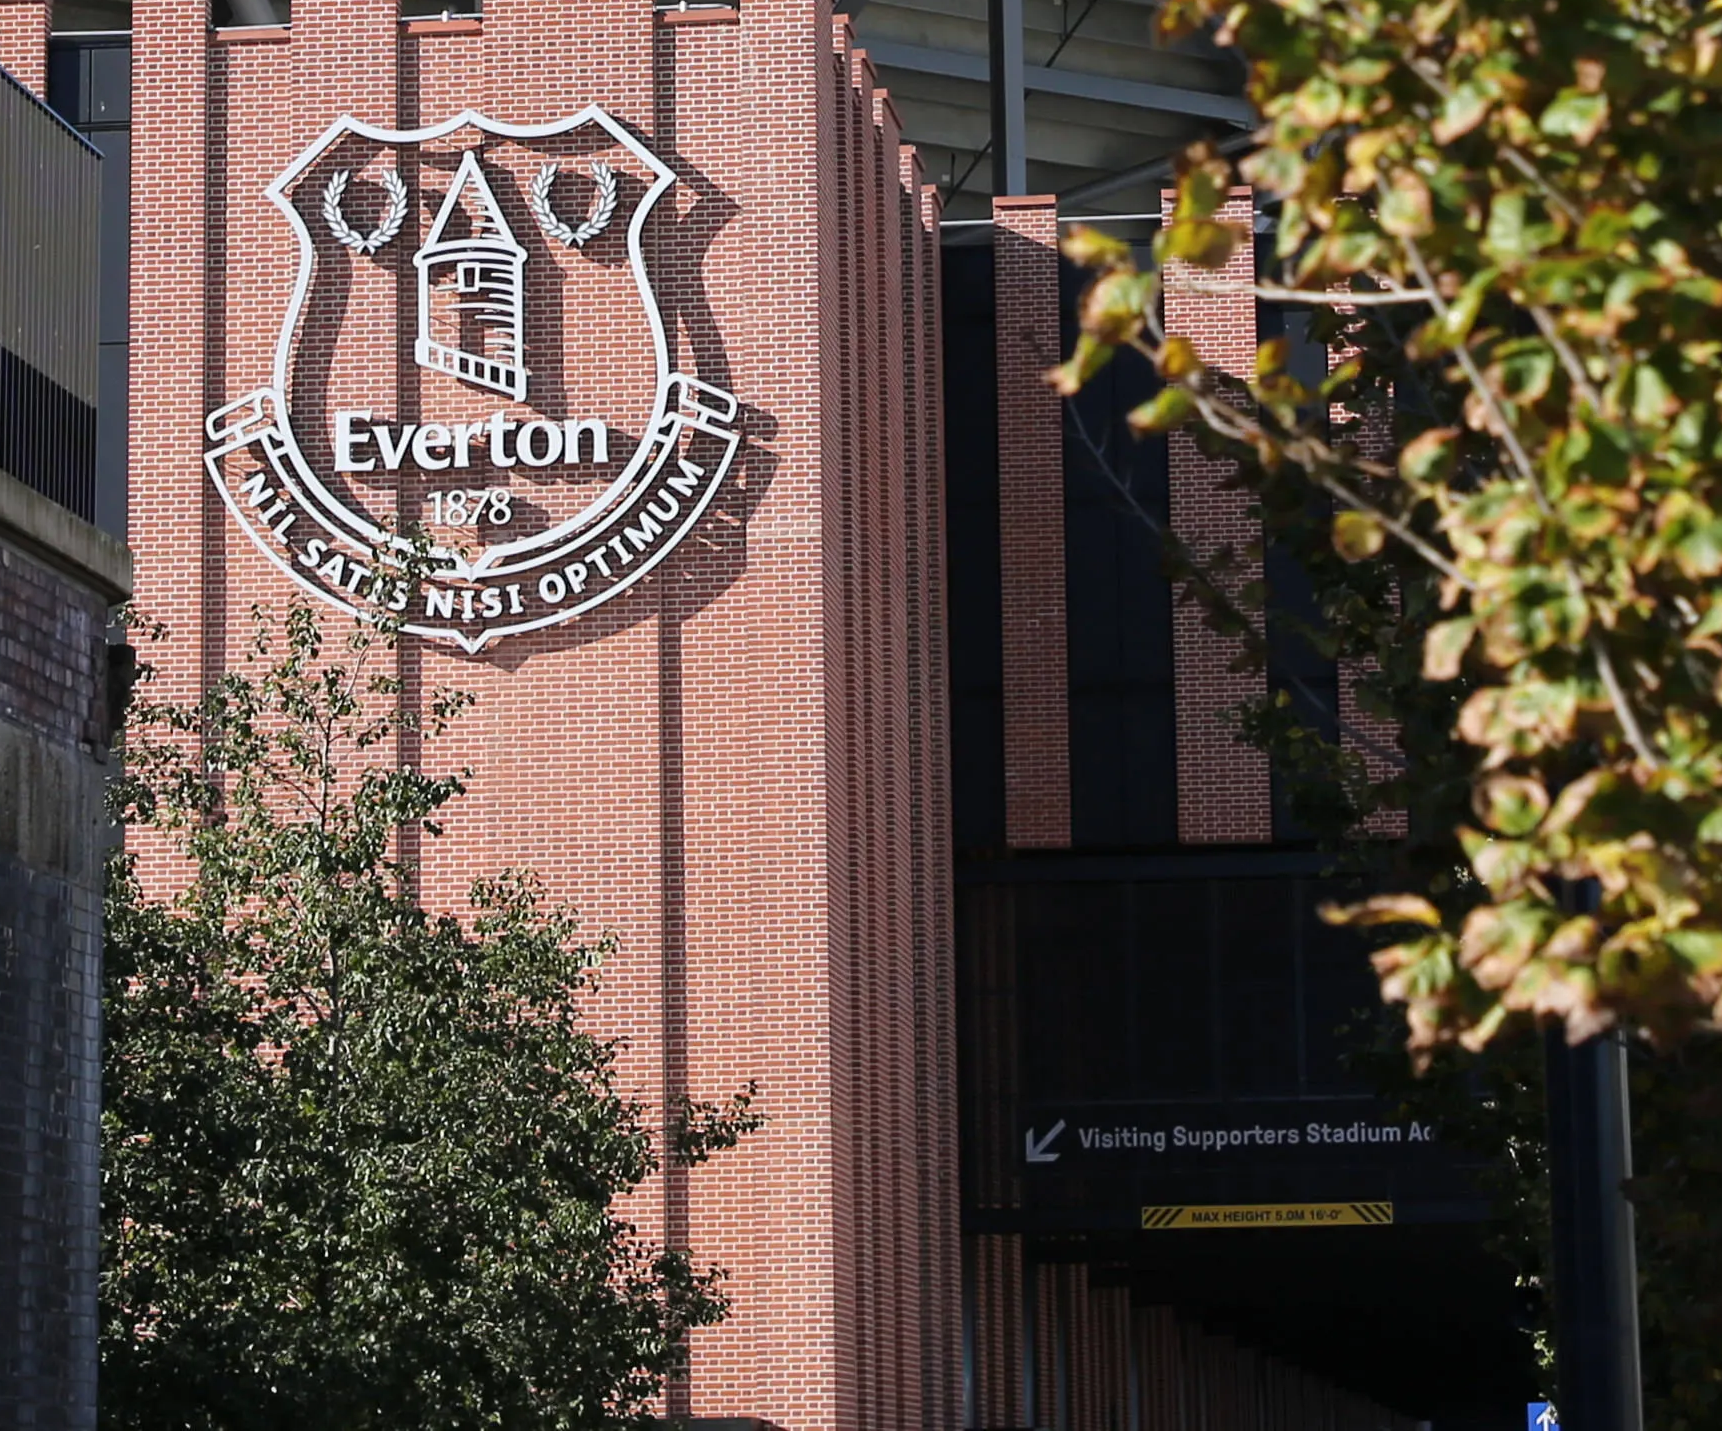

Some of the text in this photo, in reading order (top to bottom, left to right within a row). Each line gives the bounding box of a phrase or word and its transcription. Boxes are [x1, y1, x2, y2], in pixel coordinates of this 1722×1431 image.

[334, 409, 609, 472] Everton
[426, 488, 512, 526] 1878
[239, 472, 296, 545] NIL
[425, 583, 524, 620] NISI
[538, 458, 706, 604] OPTIMUM
[1079, 1127, 1166, 1152] Visiting
[1173, 1125, 1299, 1151] Supporters
[1306, 1122, 1401, 1144] Stadium
[1191, 1211, 1220, 1223] MAX
[1223, 1210, 1272, 1222] HEIGHT
[1275, 1209, 1305, 1221] 5.0M
